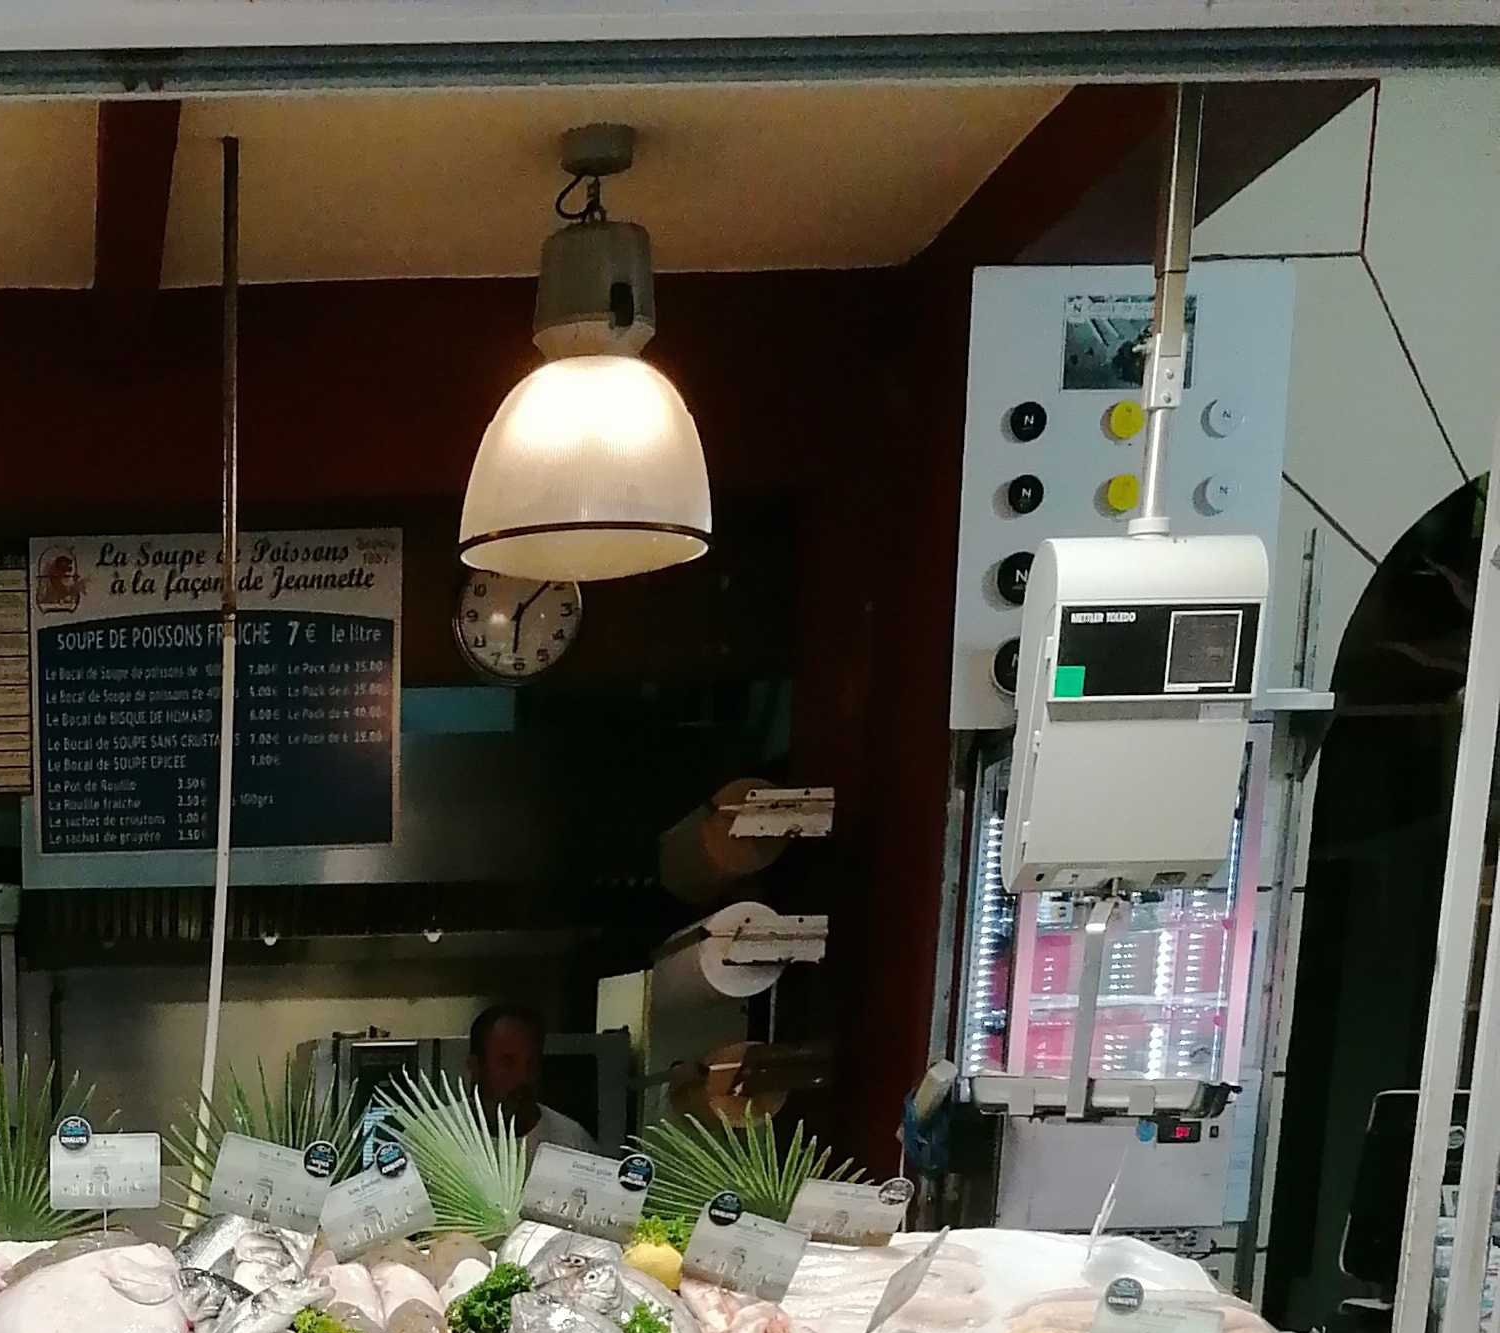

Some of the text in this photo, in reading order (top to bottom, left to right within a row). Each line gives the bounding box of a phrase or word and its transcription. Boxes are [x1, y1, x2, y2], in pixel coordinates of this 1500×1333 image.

[96, 538, 351, 573] La Soupe Poissons
[110, 566, 376, 601] à la façon de Jeannette
[466, 609, 479, 623] 9
[560, 602, 573, 617] 3
[57, 620, 383, 652] SOUPE DE POISSONS 7 € le litre
[491, 651, 502, 666] 7
[110, 710, 147, 727] BISQUE
[150, 710, 163, 724] DE
[166, 708, 213, 723] HOMARD
[113, 735, 148, 750] SOUPE
[150, 734, 178, 748] SANS
[113, 756, 148, 770] SOUPE
